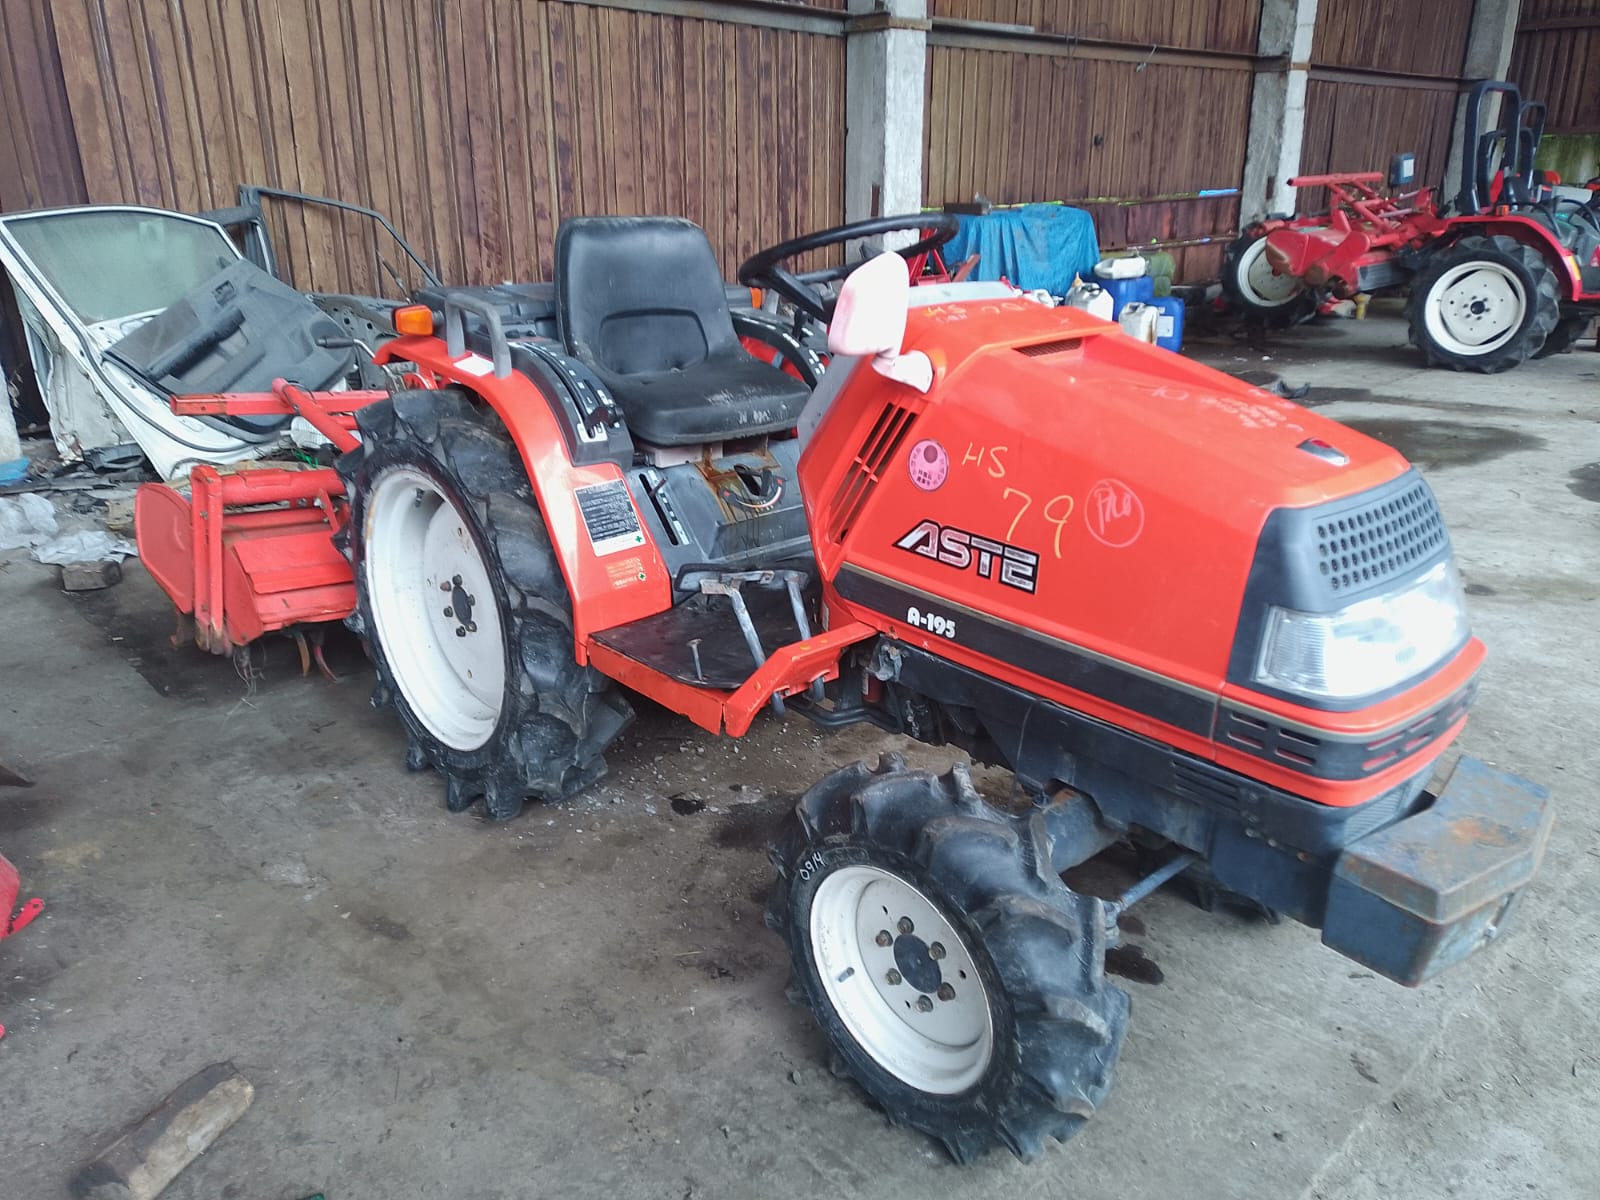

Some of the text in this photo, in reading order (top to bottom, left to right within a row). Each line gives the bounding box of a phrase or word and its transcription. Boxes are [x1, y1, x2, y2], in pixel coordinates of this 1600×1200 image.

[961, 441, 1009, 479] HS
[1003, 487, 1075, 559] 79
[893, 519, 1039, 594] ASTE
[906, 606, 956, 639] A-195
